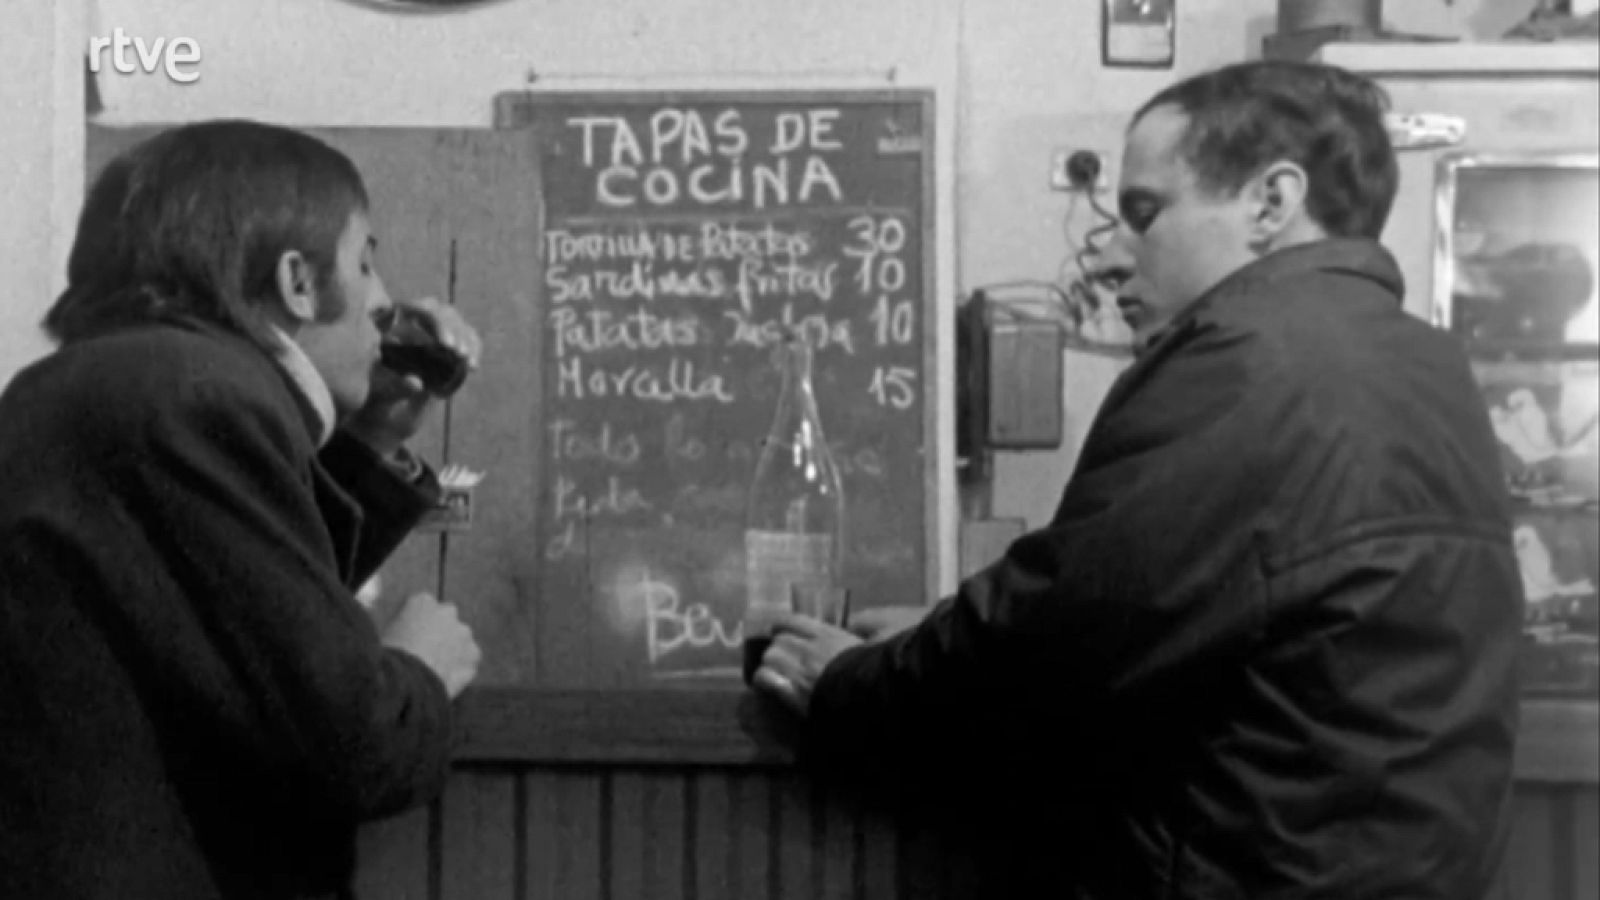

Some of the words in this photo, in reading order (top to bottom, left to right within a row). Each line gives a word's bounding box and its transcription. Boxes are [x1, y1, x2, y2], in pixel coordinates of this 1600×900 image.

[566, 107, 748, 168] TAPAS
[769, 109, 843, 155] DE
[842, 215, 907, 257] 30
[853, 254, 907, 294] 10
[868, 294, 914, 345] 10
[867, 365, 917, 409] 15
